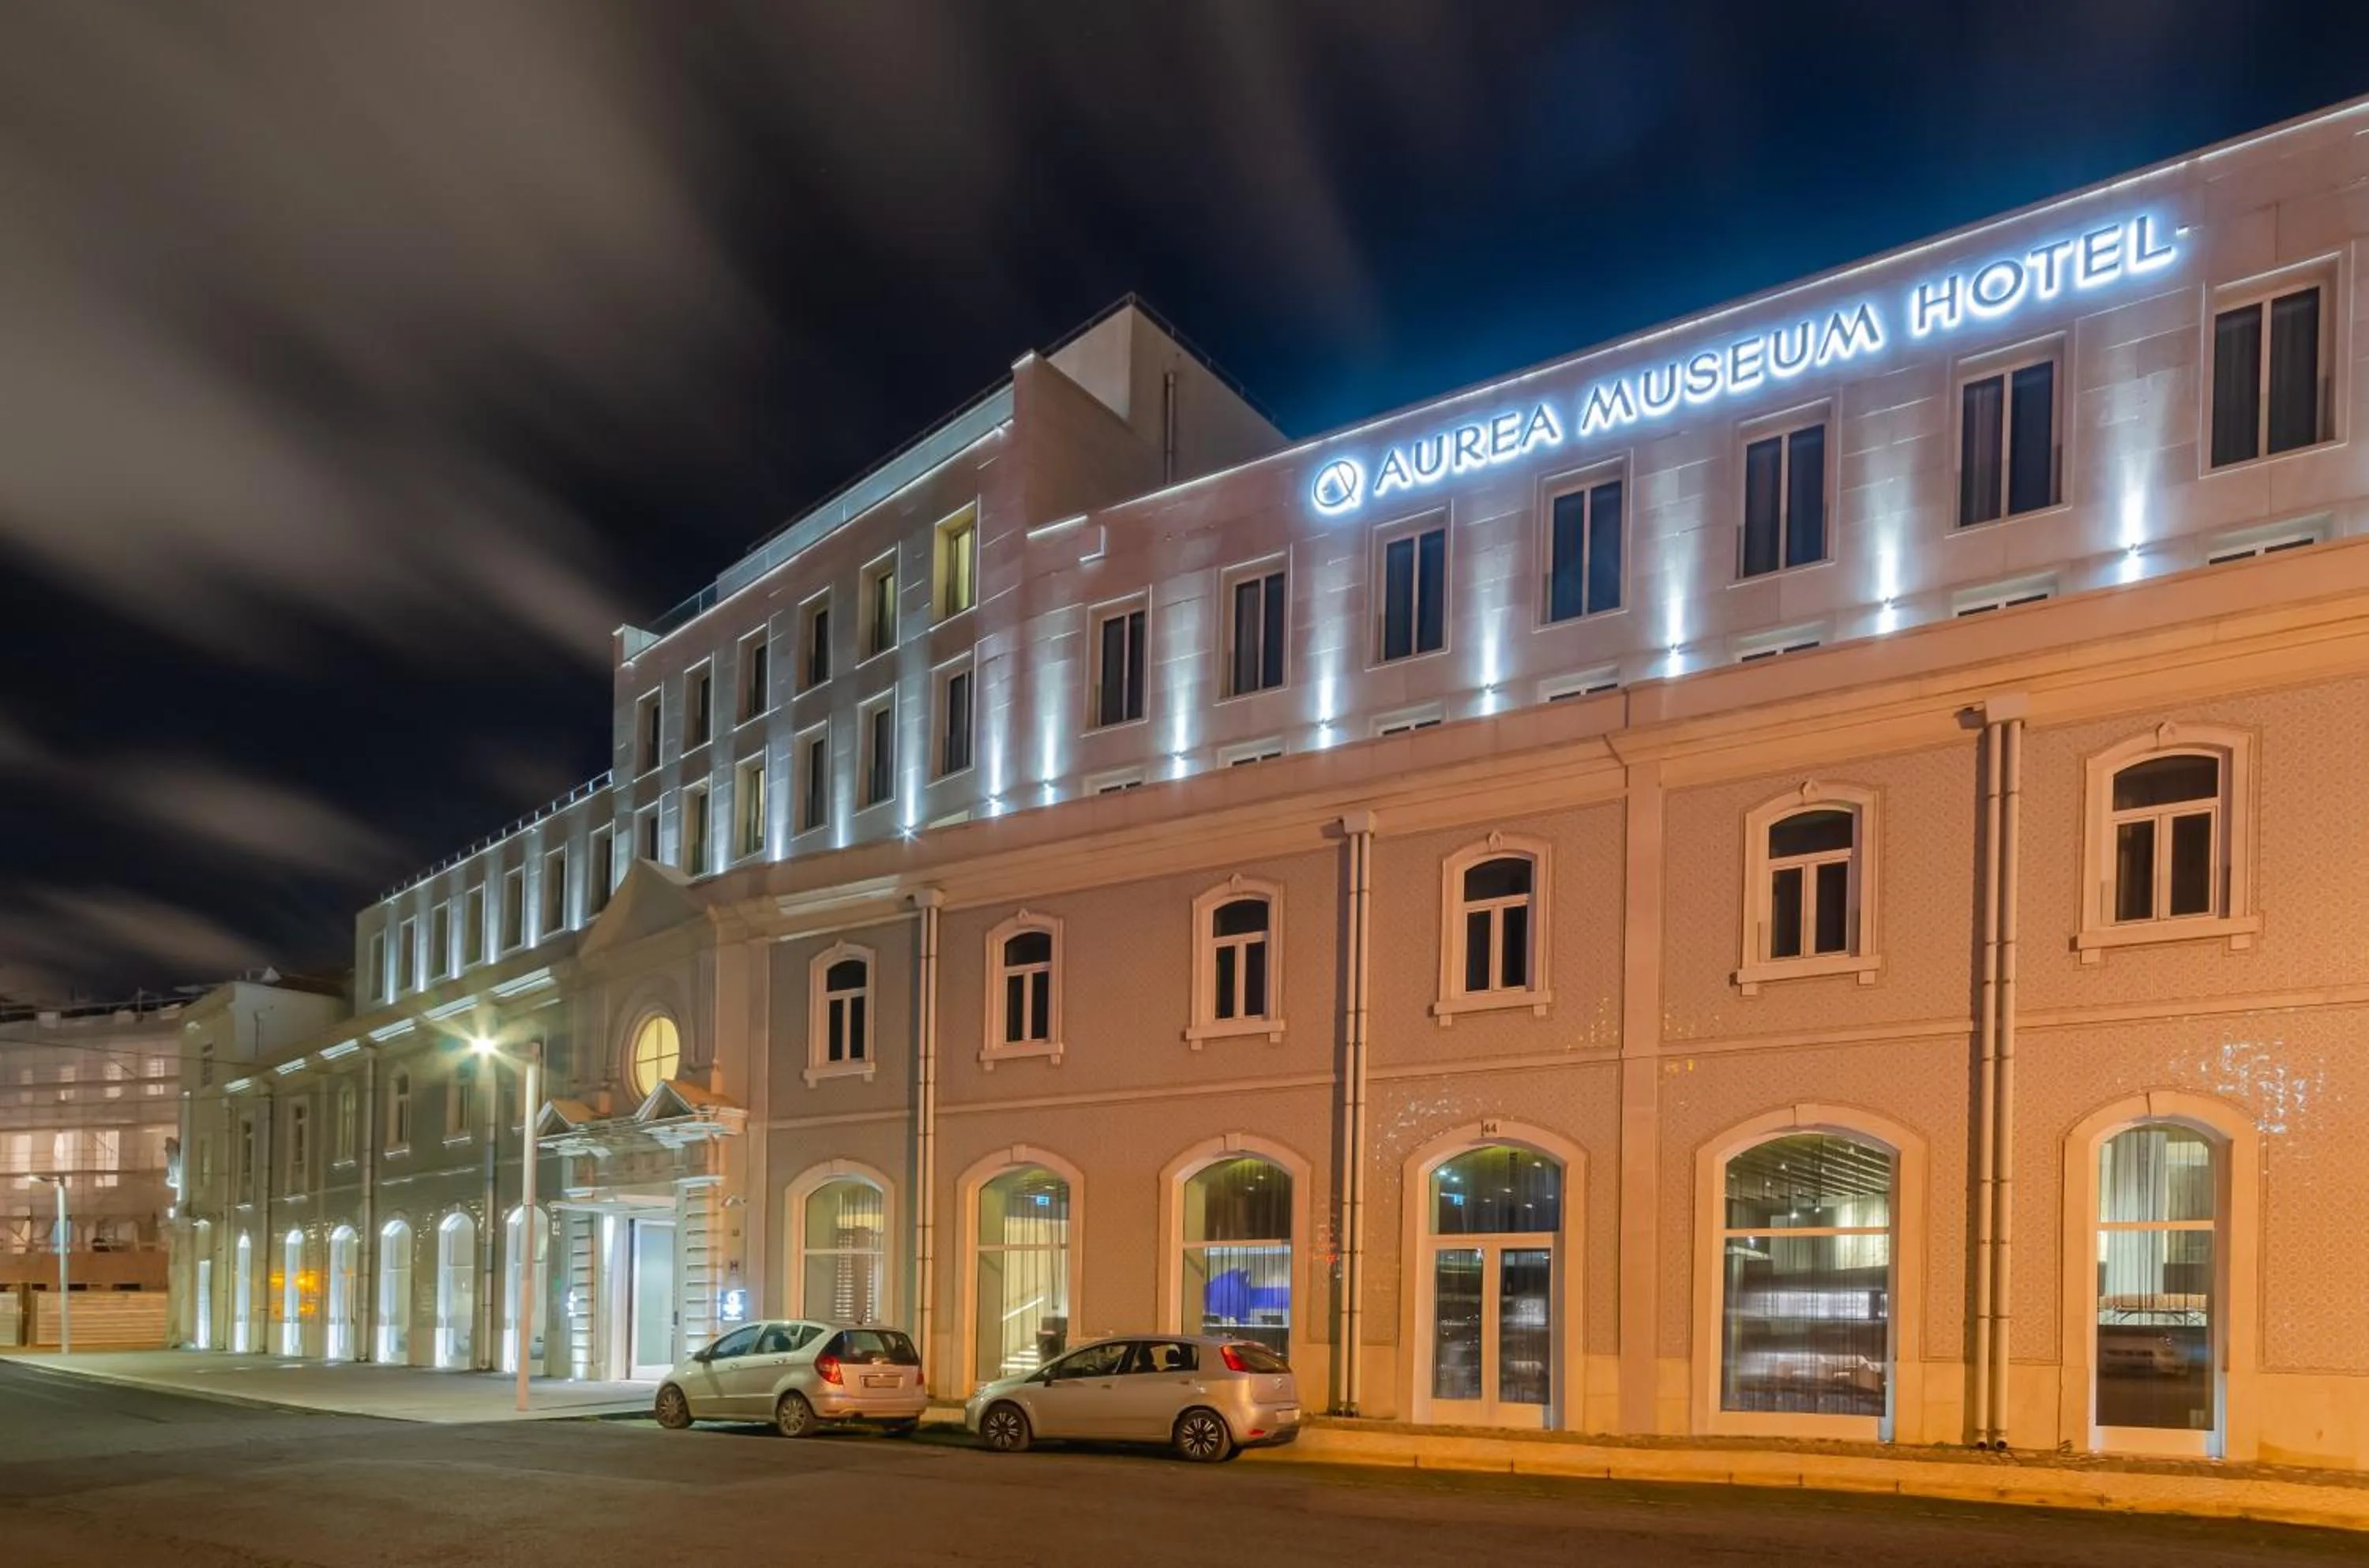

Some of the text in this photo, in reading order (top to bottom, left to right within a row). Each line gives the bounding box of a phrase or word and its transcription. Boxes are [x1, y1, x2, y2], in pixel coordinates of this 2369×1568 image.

[1374, 215, 2174, 493] AUREA MUSEUM HOTEL
